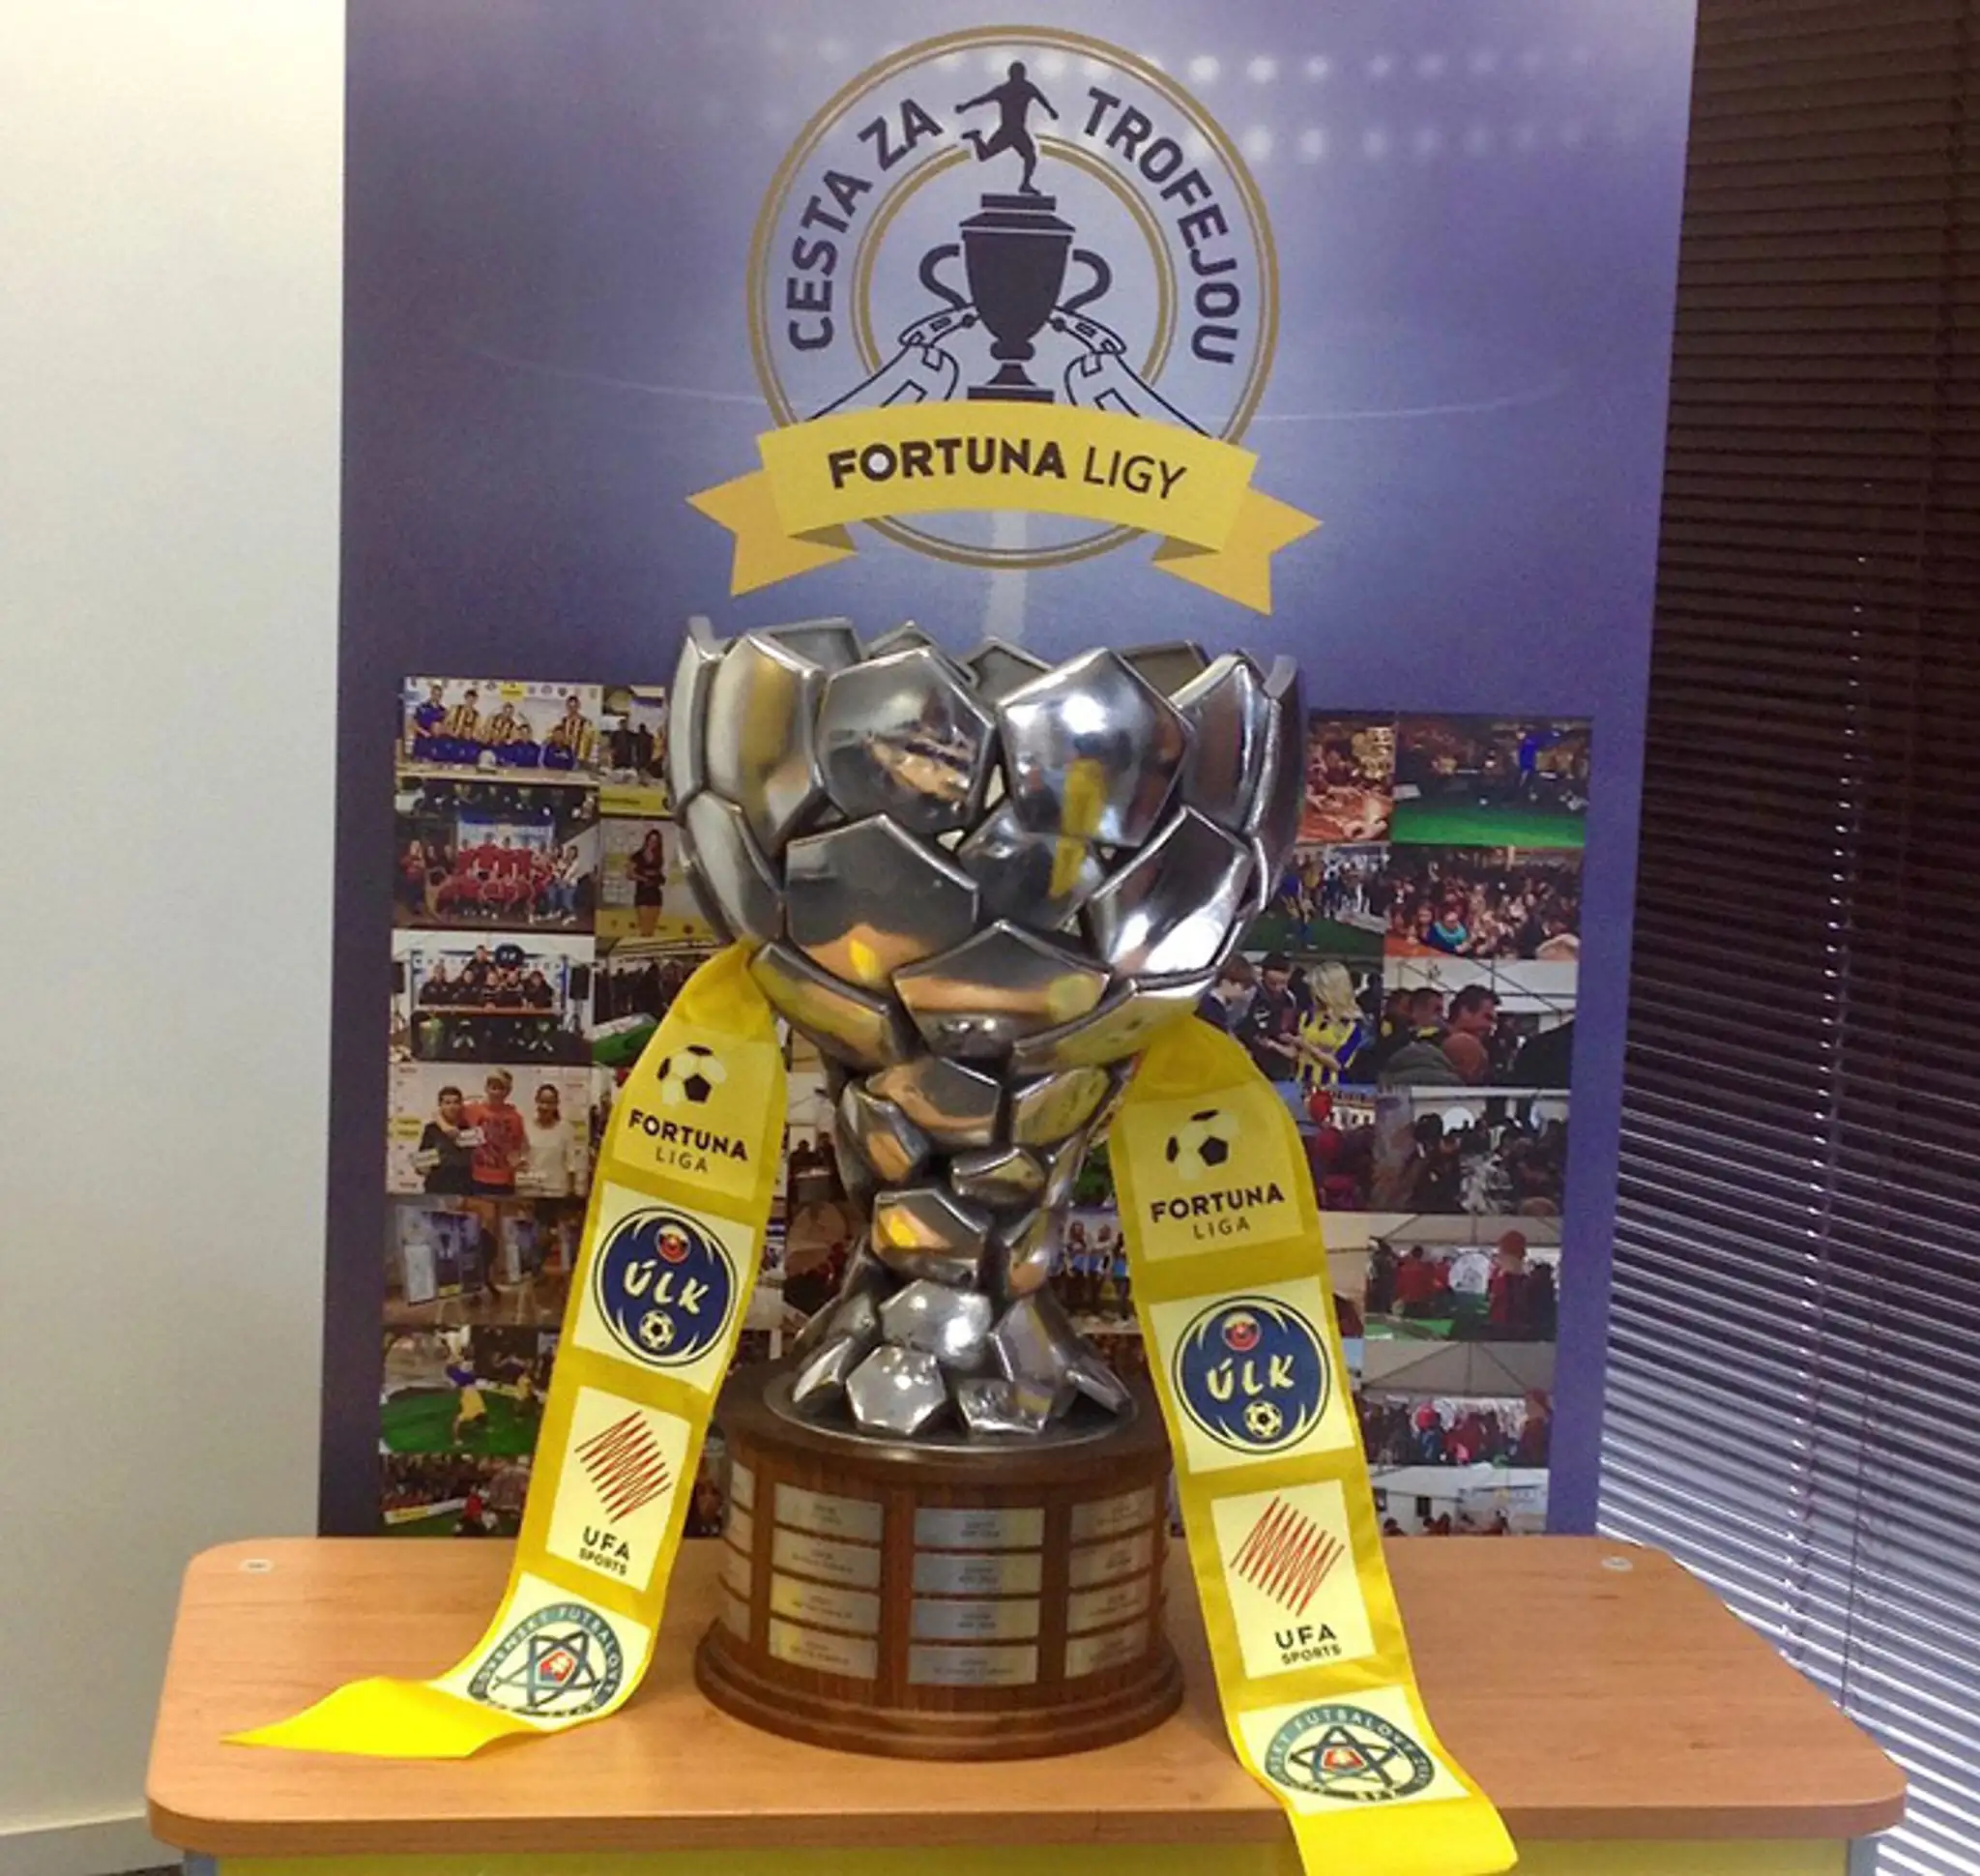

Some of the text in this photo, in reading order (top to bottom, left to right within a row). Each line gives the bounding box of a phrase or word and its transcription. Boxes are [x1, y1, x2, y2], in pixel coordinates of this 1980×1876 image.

[787, 86, 1241, 365] CESTA ZA TROFEJOU
[829, 436, 1187, 499] FORTUNA LIGY
[627, 1108, 748, 1161] FORTUNA
[655, 1146, 709, 1174] LIGA
[1150, 1183, 1286, 1224] FORTUNA
[1193, 1216, 1251, 1241] LIGA
[623, 1258, 710, 1315] ÚLK
[1206, 1354, 1296, 1401] ÚLK
[578, 1547, 628, 1577] SPORTS
[582, 1526, 630, 1561] UFA
[1274, 1624, 1338, 1651] UFA
[1281, 1642, 1343, 1666] SPORTS
